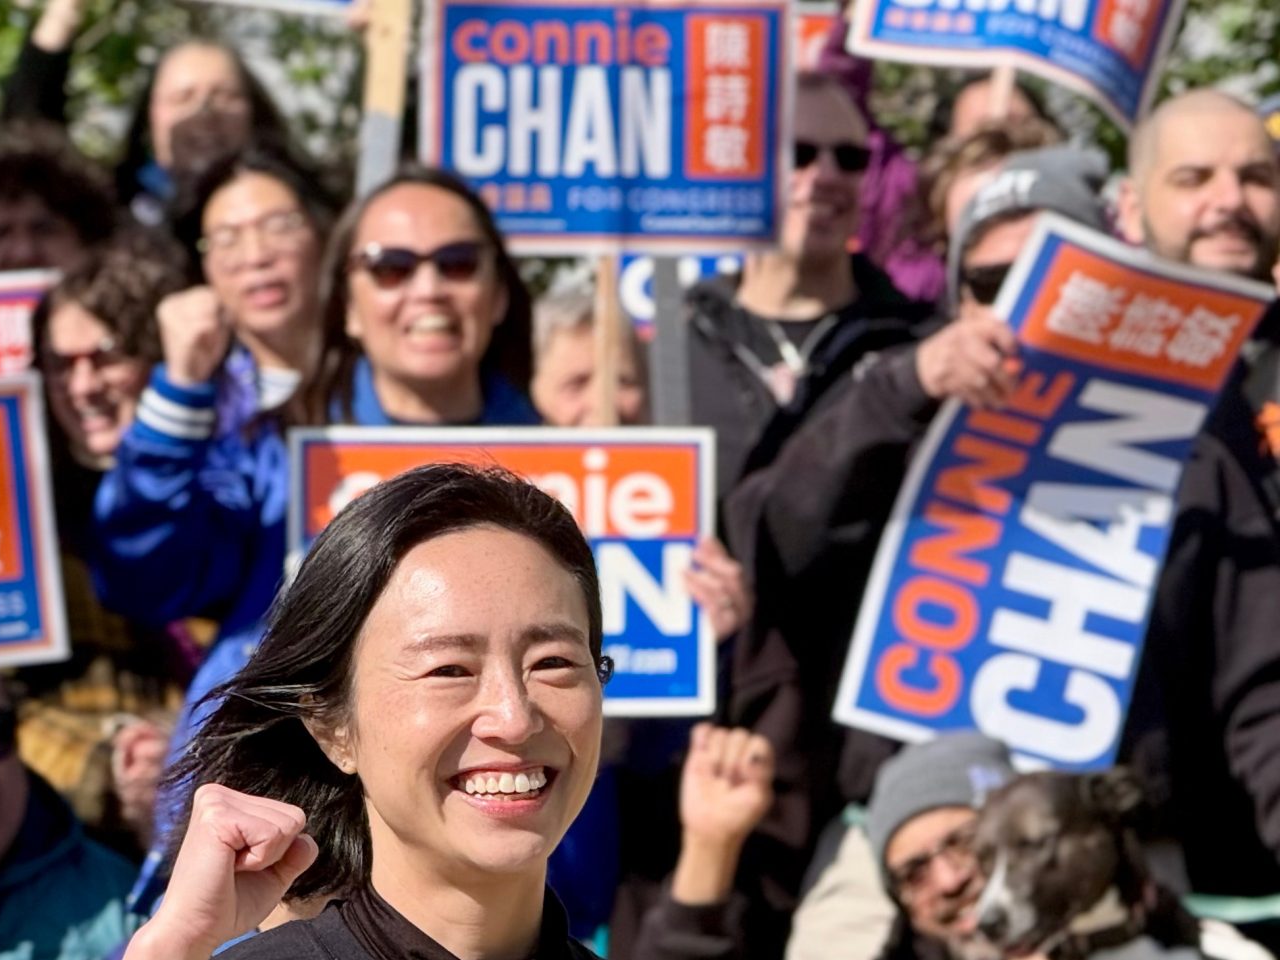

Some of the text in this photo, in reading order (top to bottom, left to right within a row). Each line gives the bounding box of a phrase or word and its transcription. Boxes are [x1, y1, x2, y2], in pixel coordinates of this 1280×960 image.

[452, 63, 671, 179] CHAN
[453, 9, 671, 65] connie
[875, 370, 1073, 717] CONNIE
[969, 378, 1209, 764] CHAN
